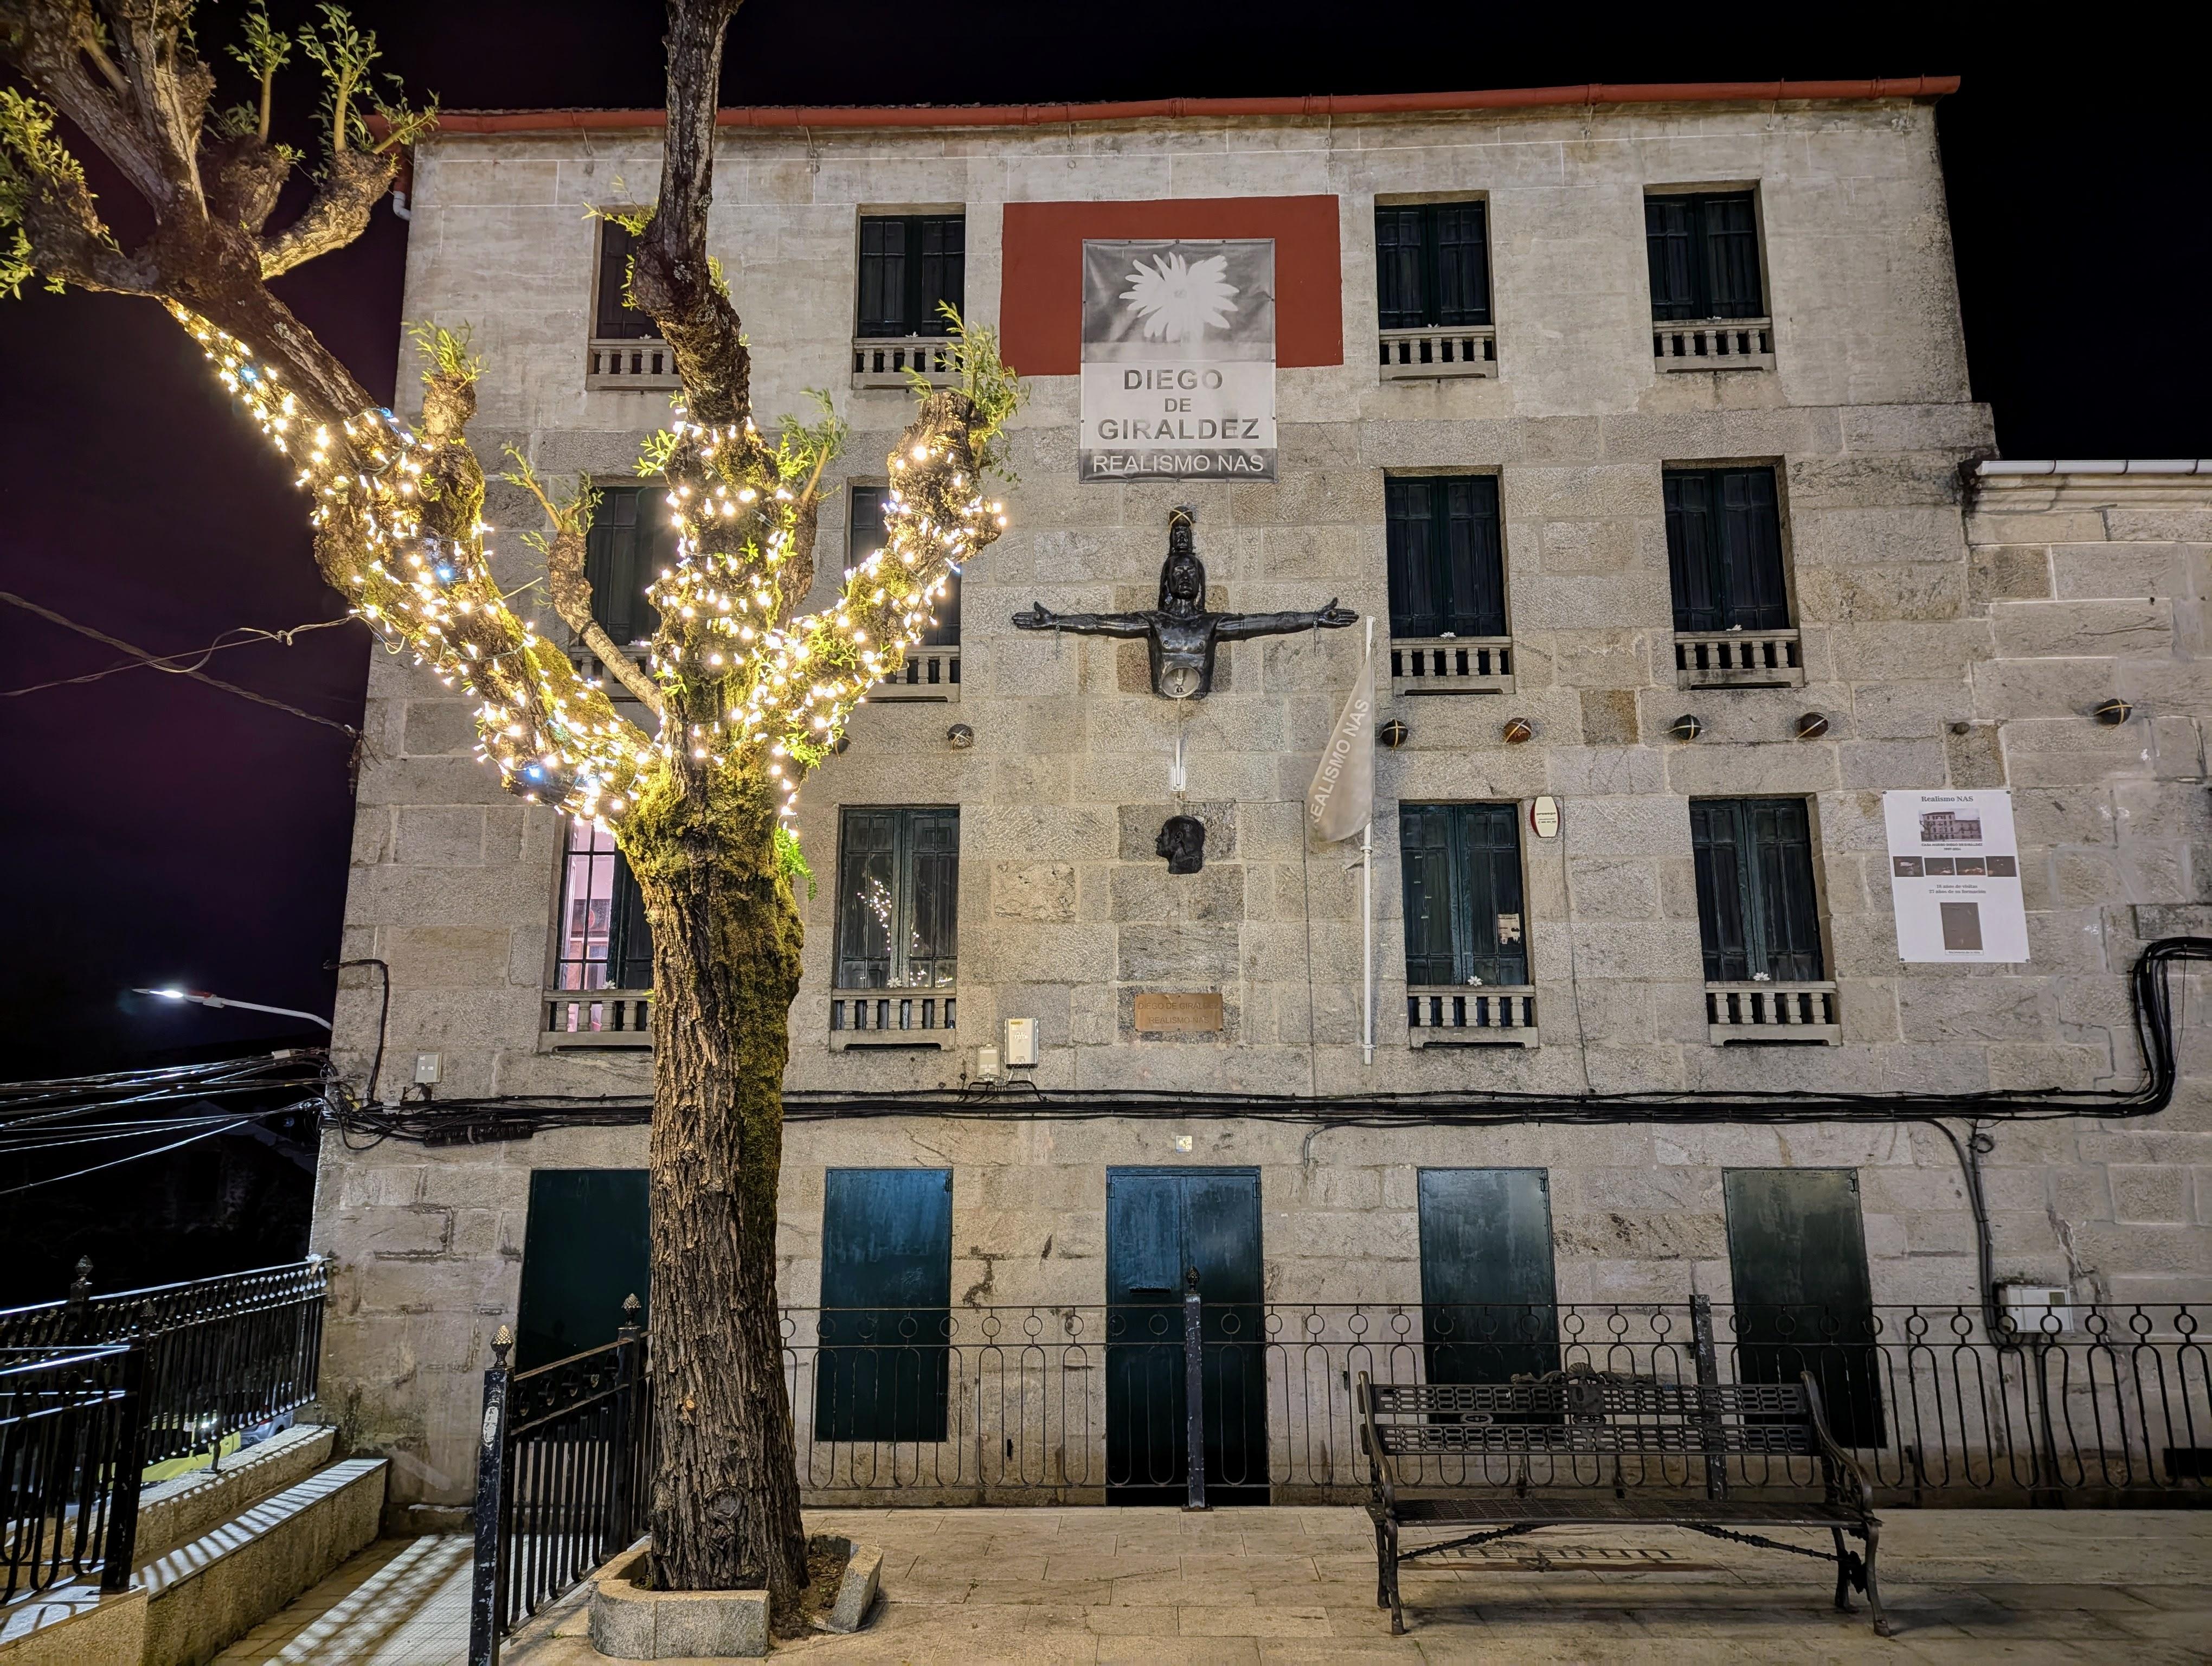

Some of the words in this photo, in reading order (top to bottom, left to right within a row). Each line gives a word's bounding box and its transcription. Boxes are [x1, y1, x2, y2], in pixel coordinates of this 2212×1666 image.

[1124, 369, 1223, 390] DIEGO
[1165, 398, 1192, 413] DE
[1098, 418, 1260, 440] GIRALDEZ
[1093, 455, 1211, 473] REALISMO
[1218, 455, 1264, 472] NAS
[1342, 699, 1369, 737] NAS
